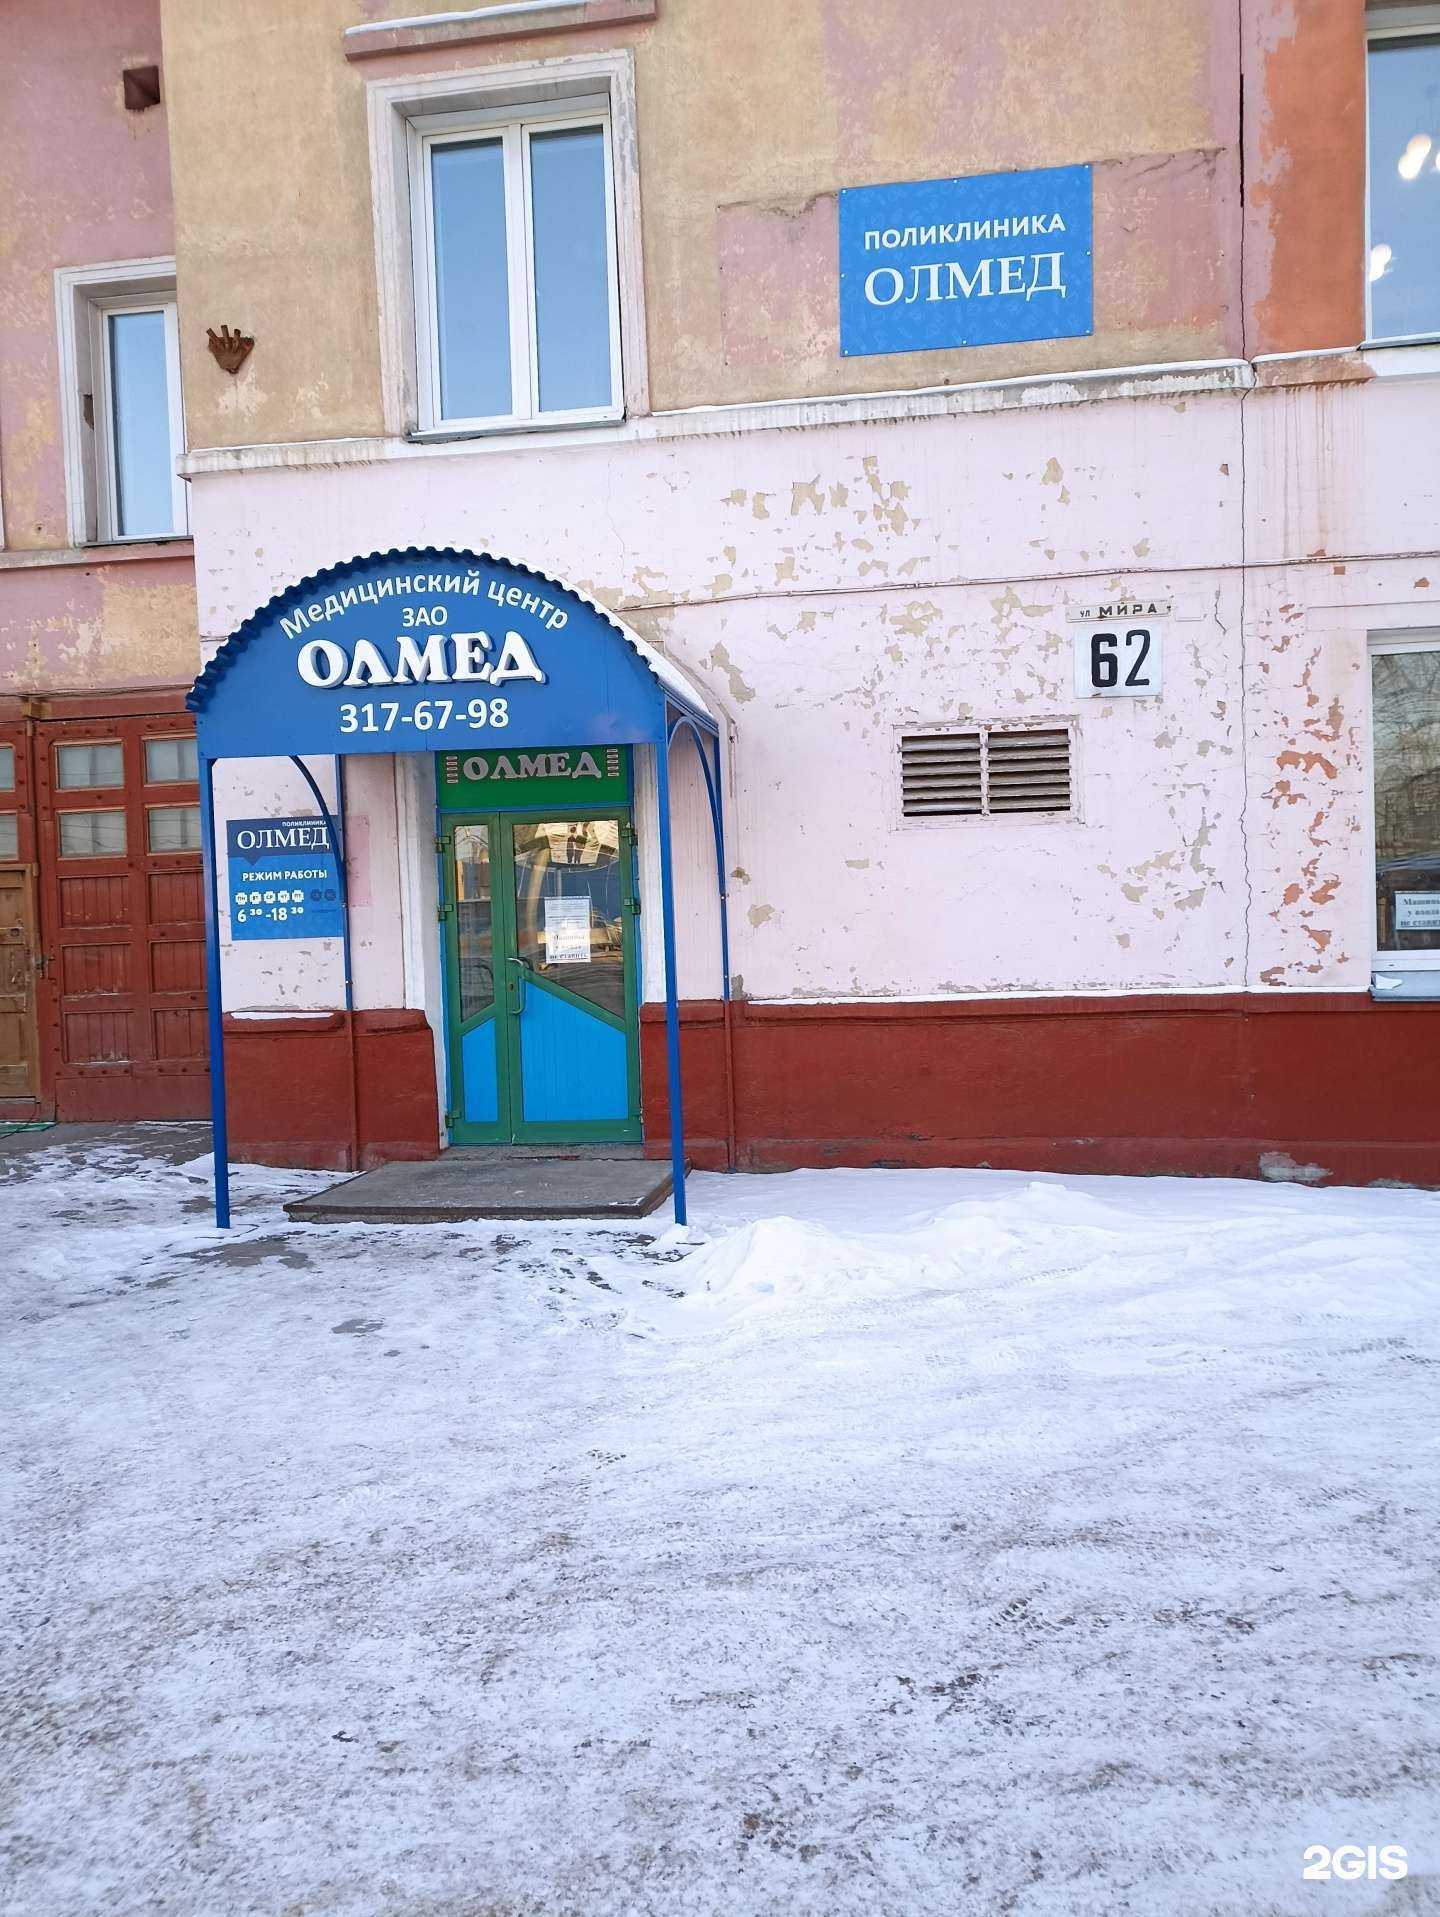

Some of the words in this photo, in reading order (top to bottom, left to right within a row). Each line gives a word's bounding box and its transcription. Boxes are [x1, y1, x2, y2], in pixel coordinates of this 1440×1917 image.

[865, 213, 1067, 251] ПОЛИКЛИНИКА
[864, 251, 1068, 306] ОЛМЕД
[280, 569, 481, 641] Медицинский
[487, 579, 569, 631] центр
[402, 606, 449, 628] ЗАО
[1099, 603, 1157, 616] МИРА
[296, 631, 548, 689] ОЛМЕД
[1090, 629, 1151, 688] 62
[340, 698, 510, 734] 317-67-98
[463, 751, 603, 781] ОЛМЕД
[237, 827, 330, 850] ОЛМЕД
[242, 871, 282, 882] РЕЖИМ
[284, 869, 328, 881] РАБОТЫ
